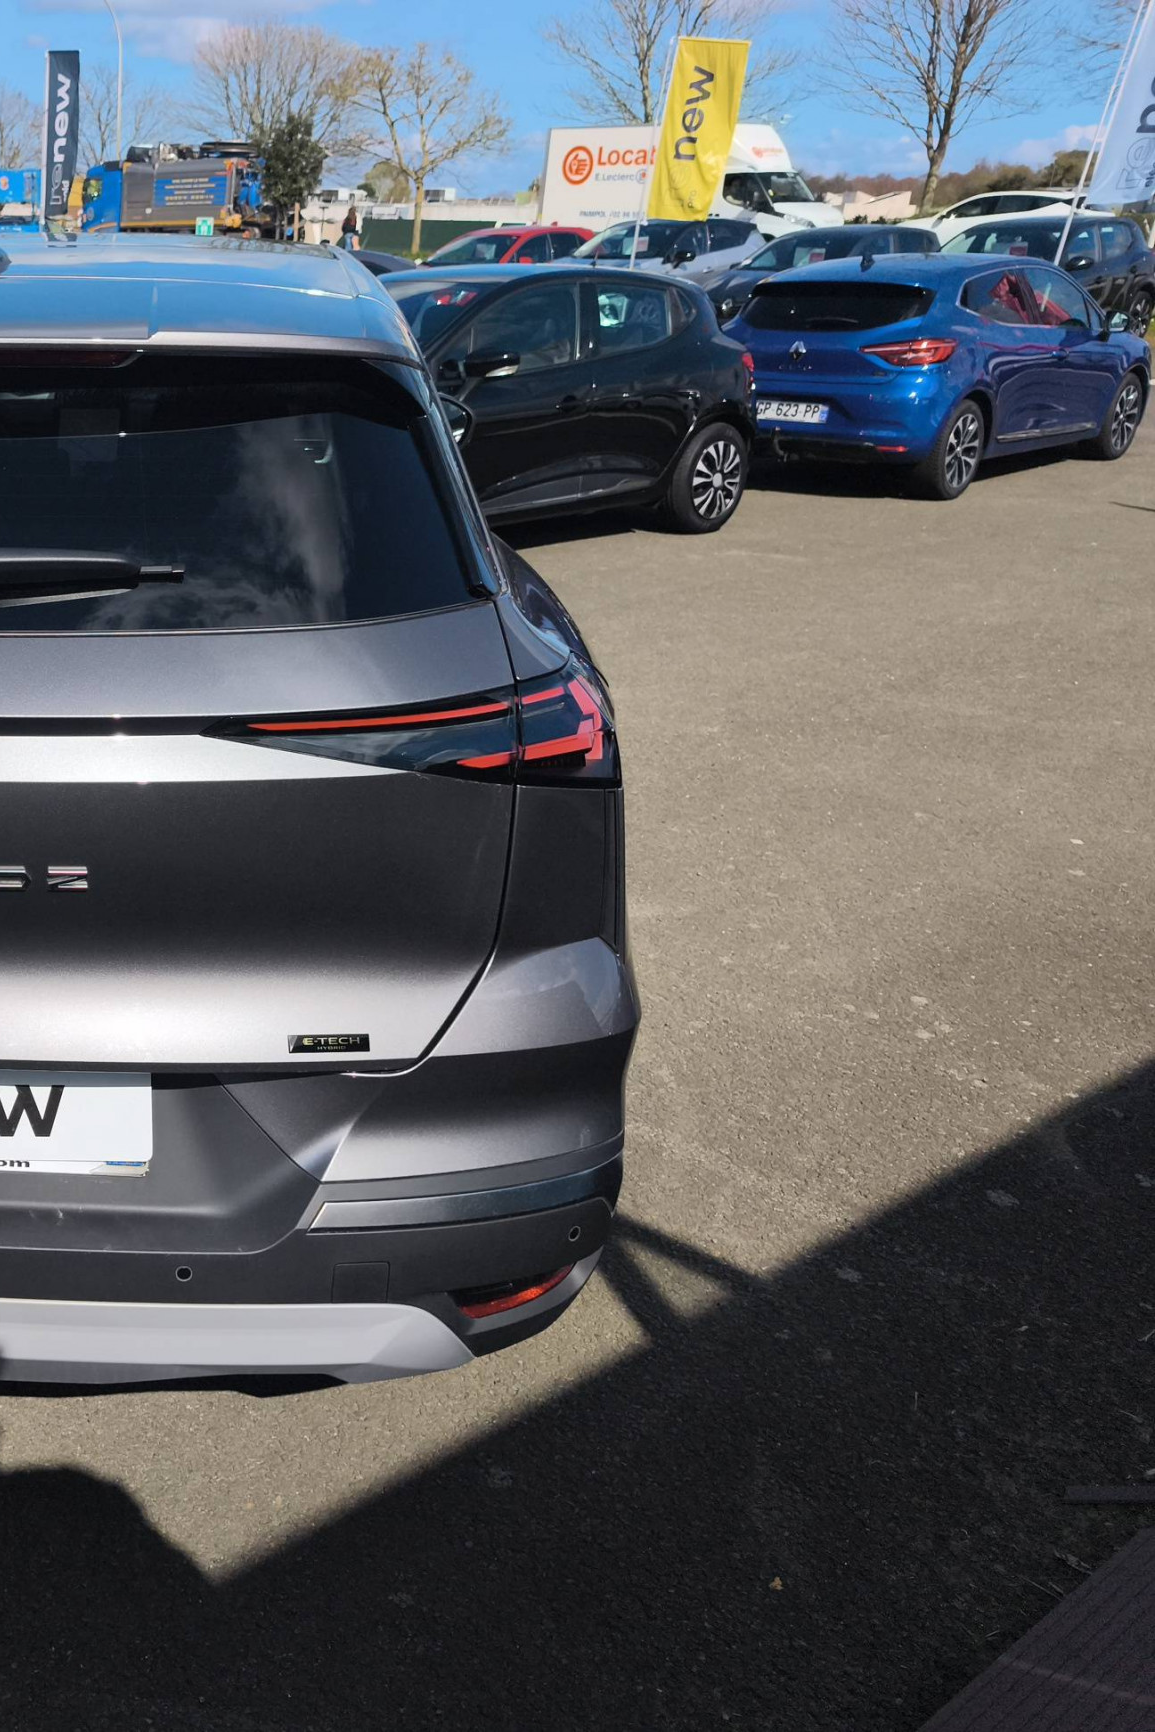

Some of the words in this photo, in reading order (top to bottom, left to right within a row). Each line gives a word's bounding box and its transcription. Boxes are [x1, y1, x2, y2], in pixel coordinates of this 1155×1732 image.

[49, 73, 71, 206] renew
[776, 403, 799, 417] 623
[302, 1036, 360, 1046] E-TECH
